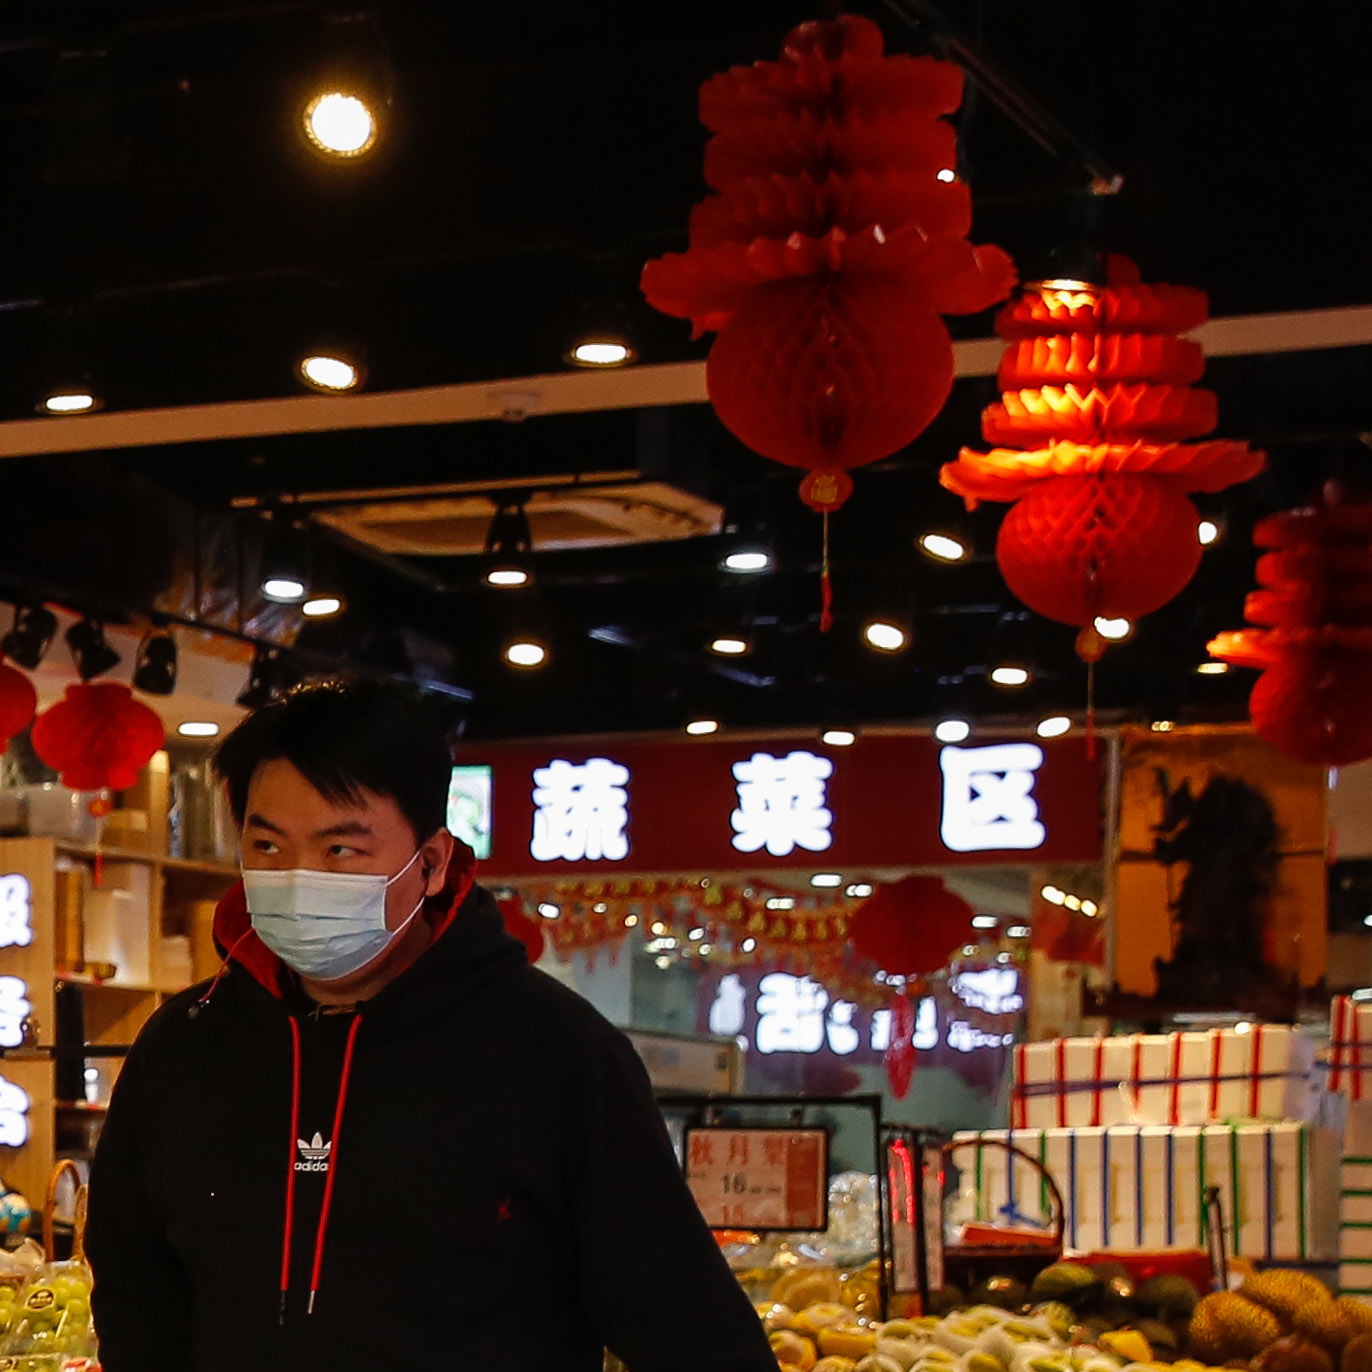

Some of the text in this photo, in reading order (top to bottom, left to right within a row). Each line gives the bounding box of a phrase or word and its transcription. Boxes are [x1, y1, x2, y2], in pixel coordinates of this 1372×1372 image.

[530, 742, 1047, 862] 蔬菜区
[293, 1159, 329, 1172] adida
